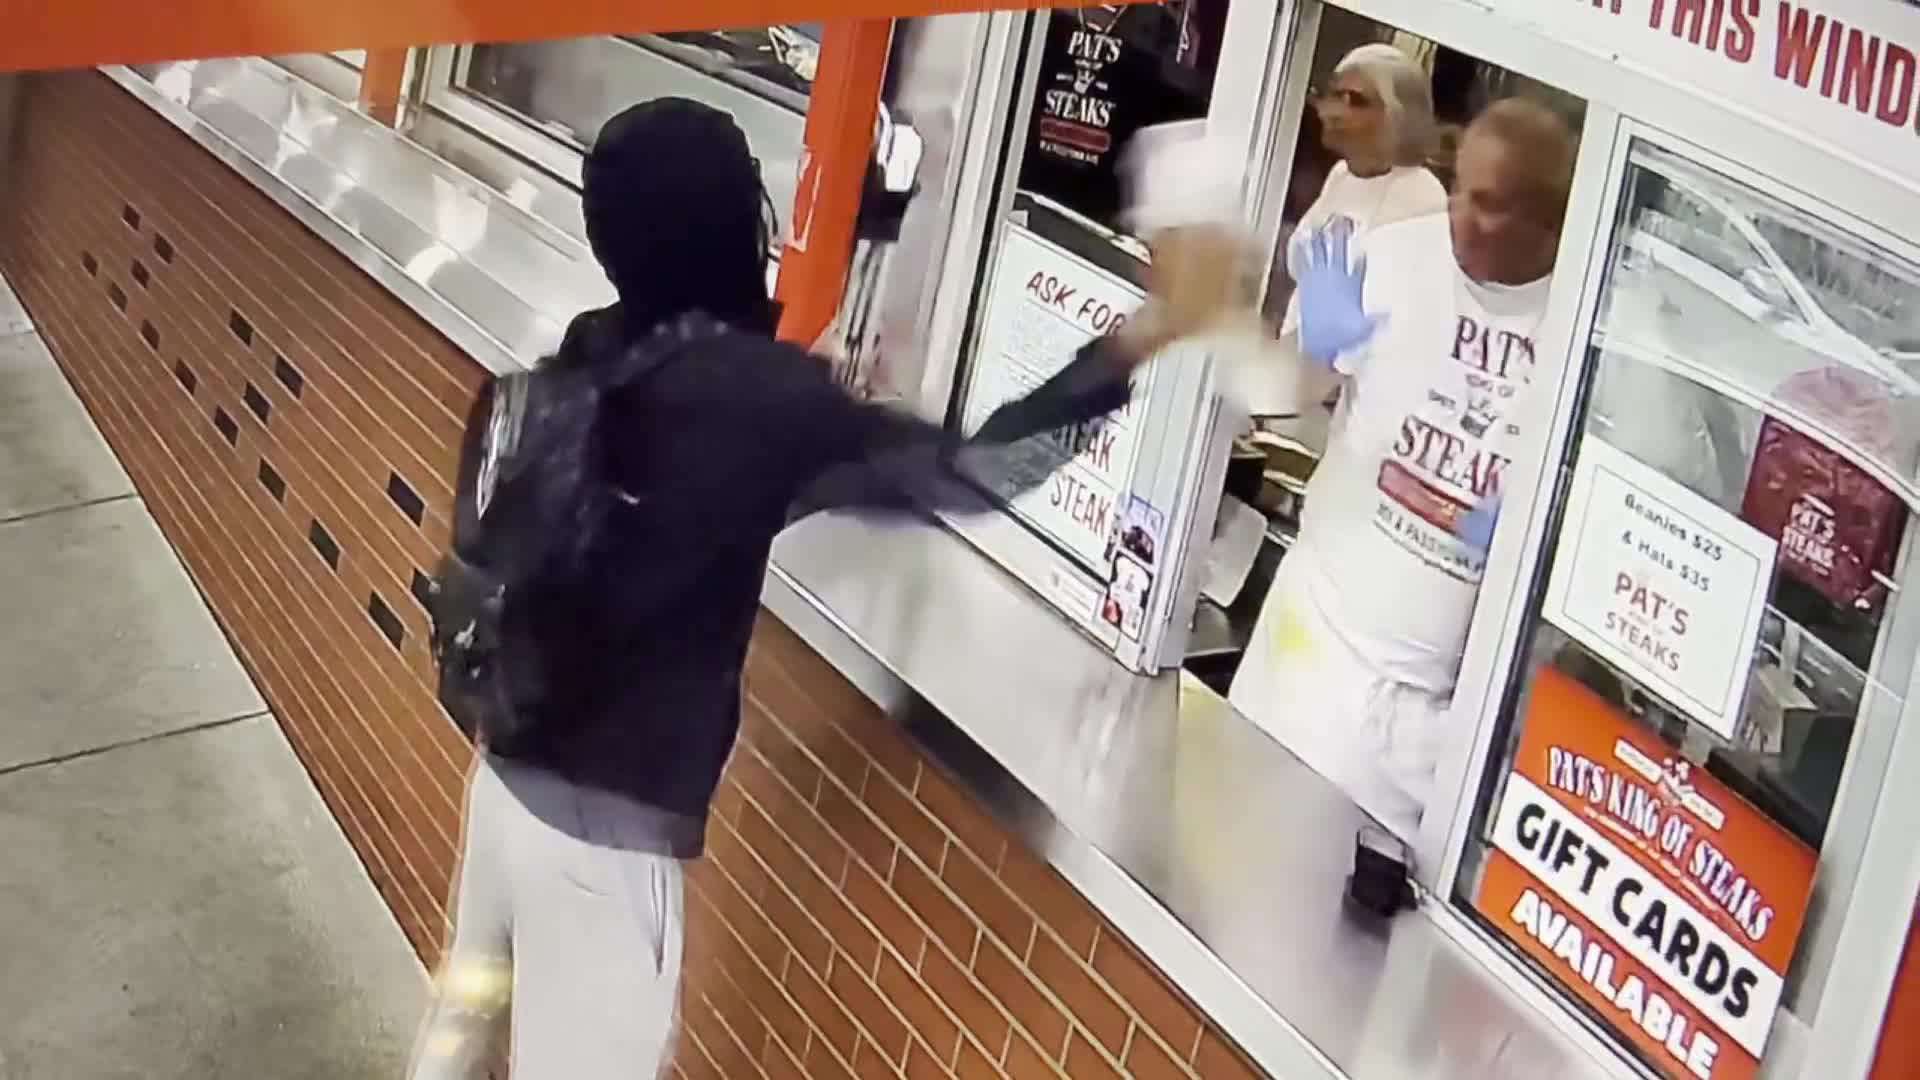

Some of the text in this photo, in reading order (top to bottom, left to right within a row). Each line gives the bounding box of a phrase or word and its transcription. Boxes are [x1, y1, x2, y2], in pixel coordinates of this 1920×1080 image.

[1774, 1, 1920, 137] WIND
[1045, 89, 1112, 128] STEAKS
[1027, 271, 1127, 335] ASK FOR
[1050, 472, 1112, 540] STEAK
[1624, 493, 1724, 562] Beanies $25
[1638, 540, 1675, 571] Hats
[1679, 562, 1711, 593] $35
[1614, 572, 1690, 636] PAT'S
[1604, 611, 1681, 672] STEAKS
[1607, 772, 1662, 839] KING
[1661, 814, 1695, 860] OF
[1688, 839, 1776, 942] STEAKS
[1516, 803, 1610, 896] GIFT
[1612, 877, 1760, 1019] CARDS
[1510, 888, 1721, 1080] AVAILABLE
